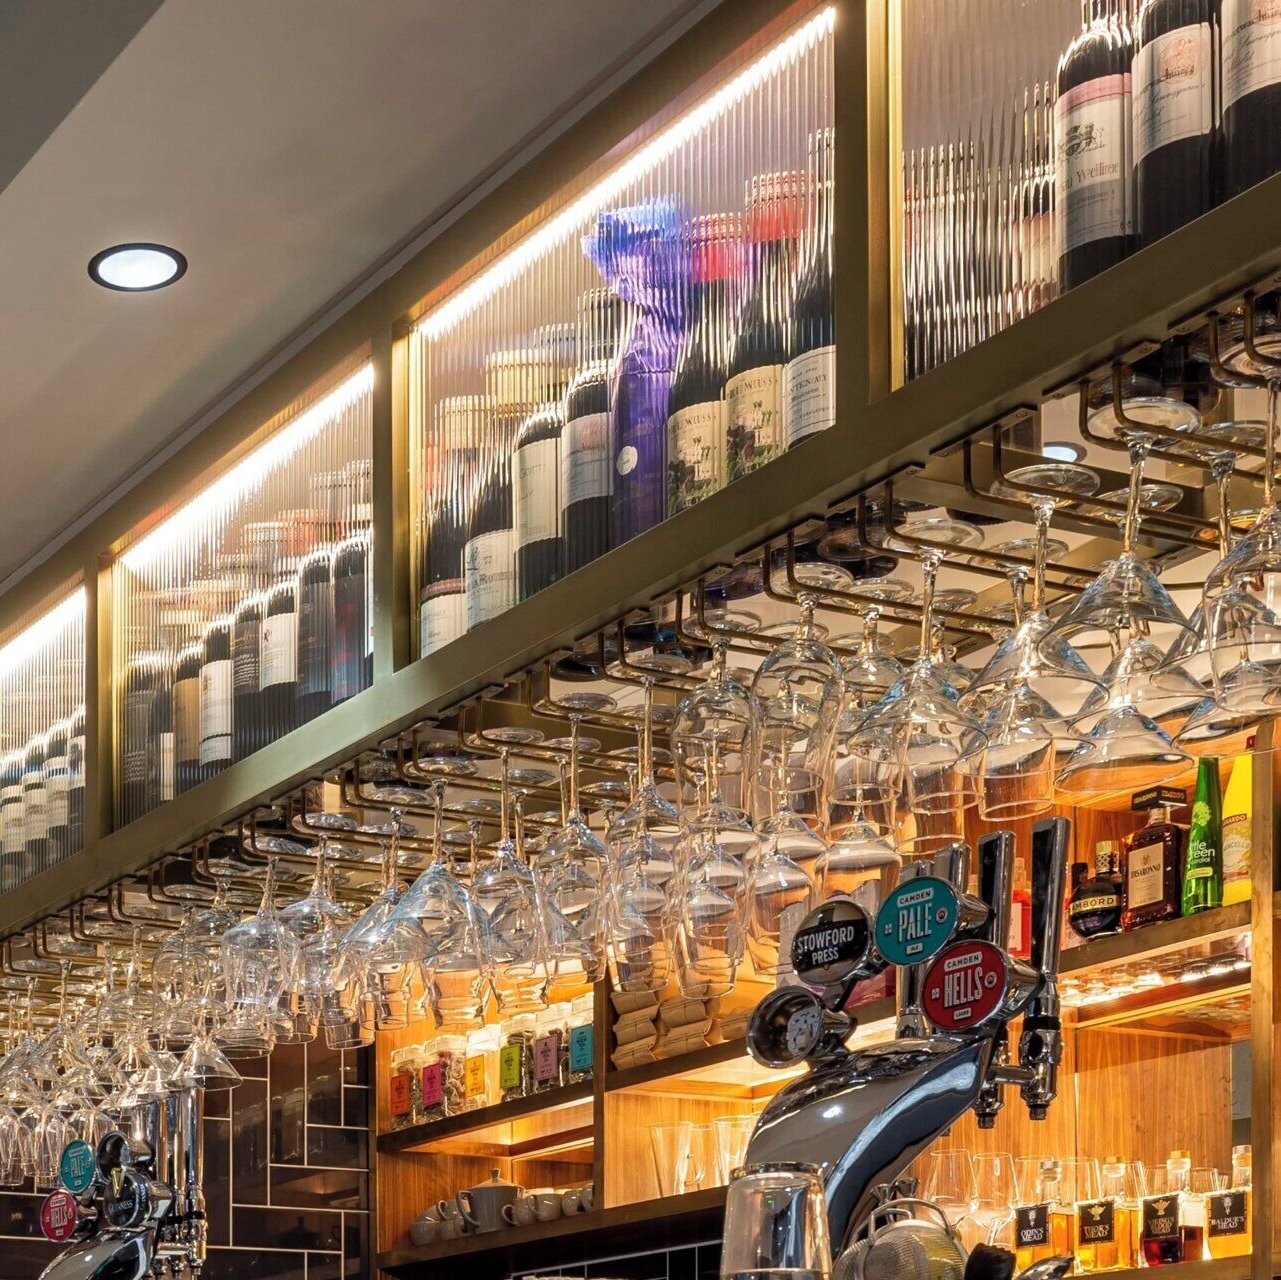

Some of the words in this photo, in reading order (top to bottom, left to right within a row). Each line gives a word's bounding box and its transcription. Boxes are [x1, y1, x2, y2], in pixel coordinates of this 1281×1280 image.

[899, 889, 932, 905] CAMDEN
[898, 903, 933, 942] PALE
[797, 925, 855, 954] STOWFORD
[811, 947, 839, 966] PRESS
[946, 953, 980, 969] CAMDEN
[944, 966, 983, 1008] HELLS
[1210, 1214, 1245, 1225] BALDUR'S
[1217, 1220, 1238, 1230] MEAD
[1020, 1227, 1044, 1237] ODIN'S
[1083, 1224, 1110, 1233] THOR'S
[1084, 1230, 1108, 1239] MEAD
[1021, 1232, 1044, 1242] MEAD
